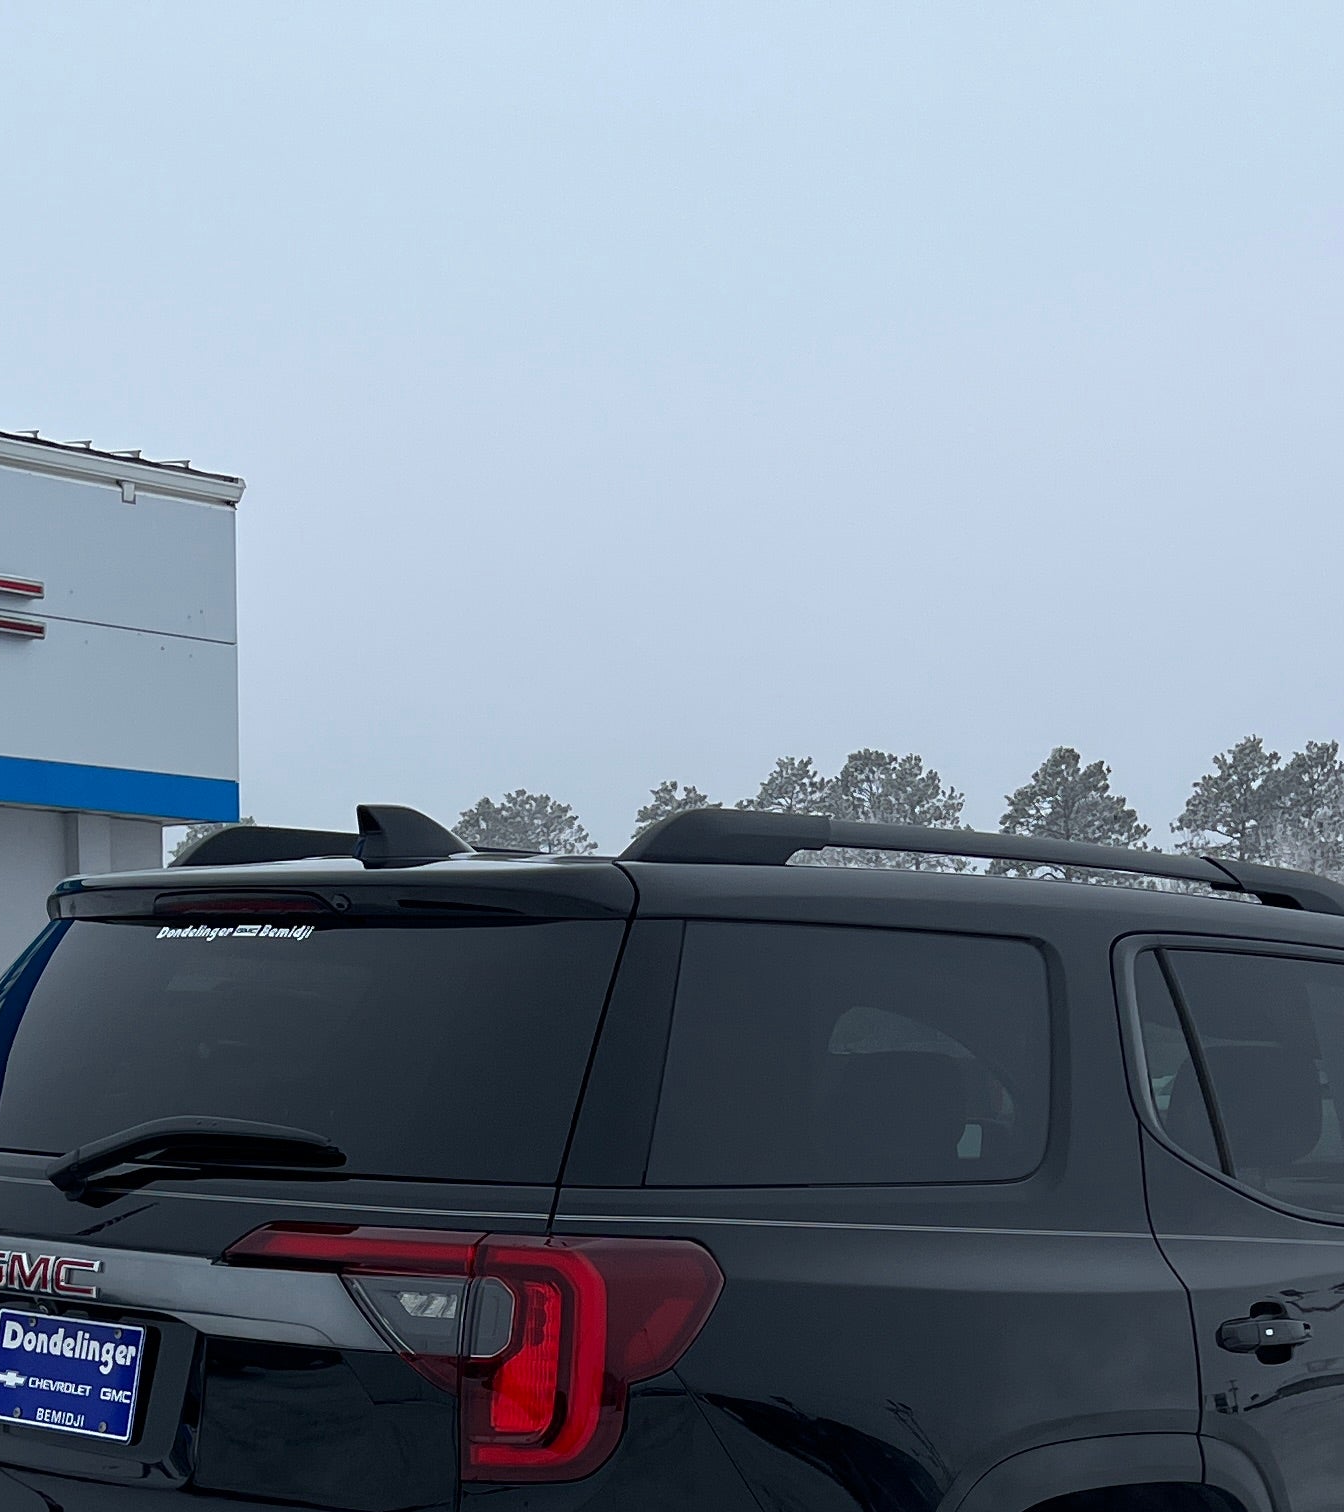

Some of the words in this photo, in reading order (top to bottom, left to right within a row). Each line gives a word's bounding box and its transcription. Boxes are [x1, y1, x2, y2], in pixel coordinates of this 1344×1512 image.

[156, 925, 233, 942] Dondelinger
[259, 924, 315, 941] Bemidji
[2, 1320, 136, 1375] Dondelinger
[28, 1377, 92, 1397] CHEVROLET
[99, 1387, 132, 1404] GMC
[35, 1407, 85, 1428] BEMIDJI
